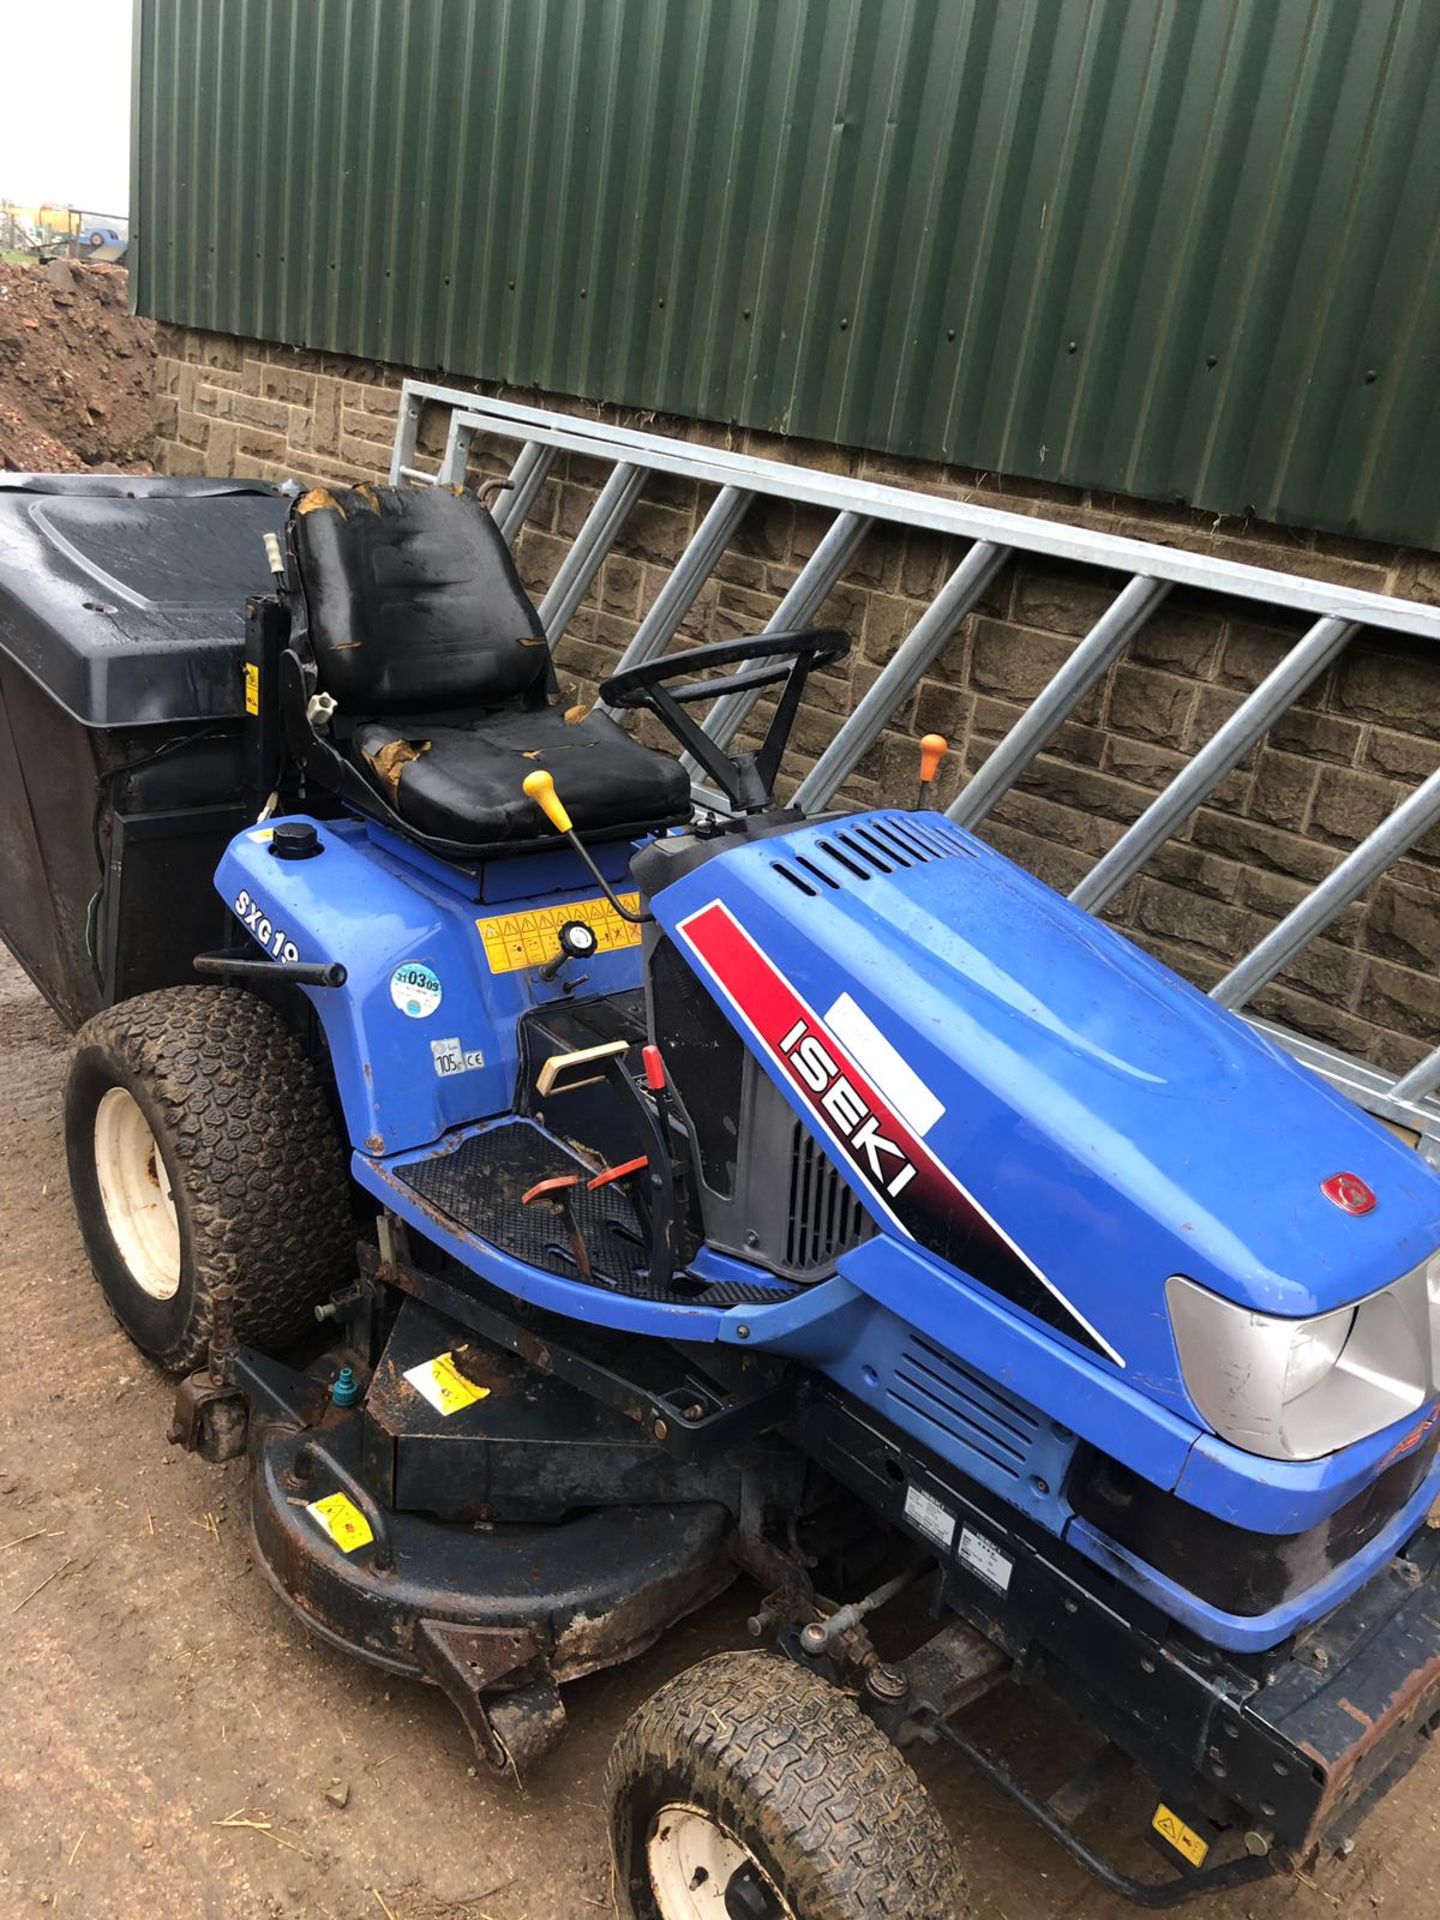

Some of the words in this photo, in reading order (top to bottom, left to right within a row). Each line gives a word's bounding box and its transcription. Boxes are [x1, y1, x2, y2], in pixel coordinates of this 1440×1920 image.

[408, 970, 426, 988] 03
[426, 980, 439, 992] 09
[436, 1053, 457, 1074] 105
[778, 1018, 918, 1198] ISEKI
